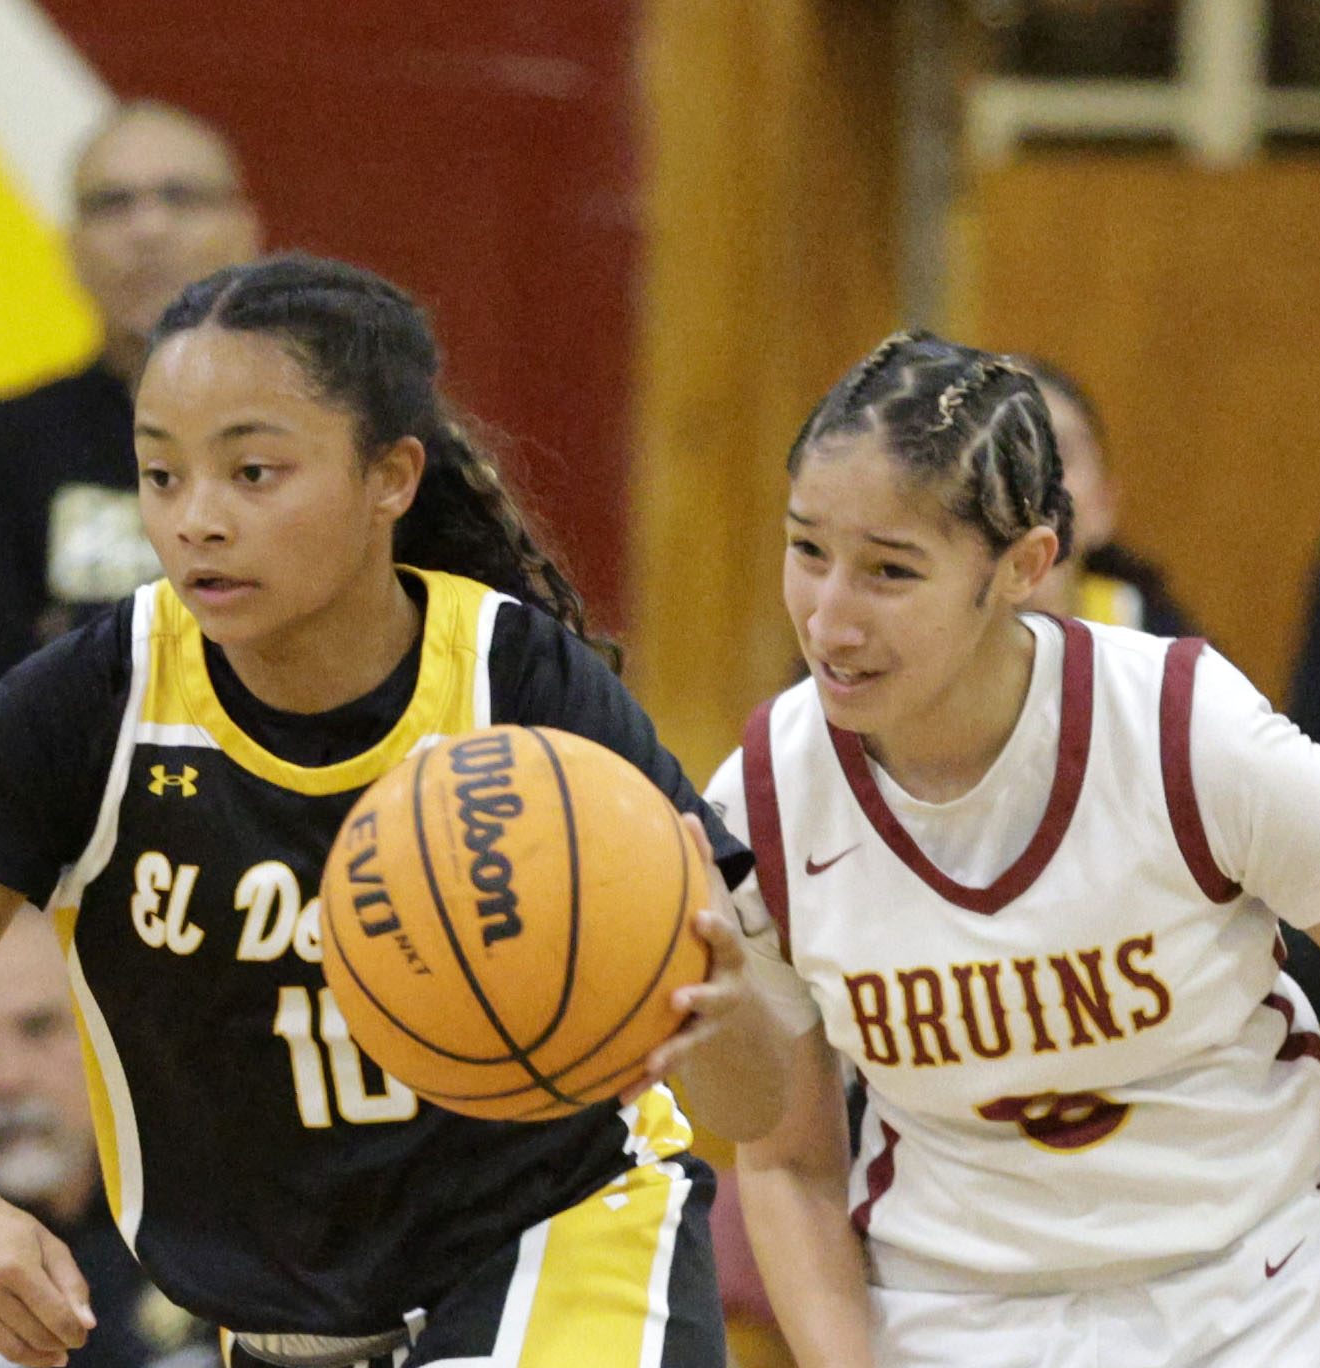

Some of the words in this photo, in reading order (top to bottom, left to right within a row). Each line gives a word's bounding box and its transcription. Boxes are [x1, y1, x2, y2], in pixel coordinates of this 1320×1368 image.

[347, 811, 402, 938] EVO
[448, 733, 523, 948] Wilson
[842, 930, 1174, 1068] BRUINS
